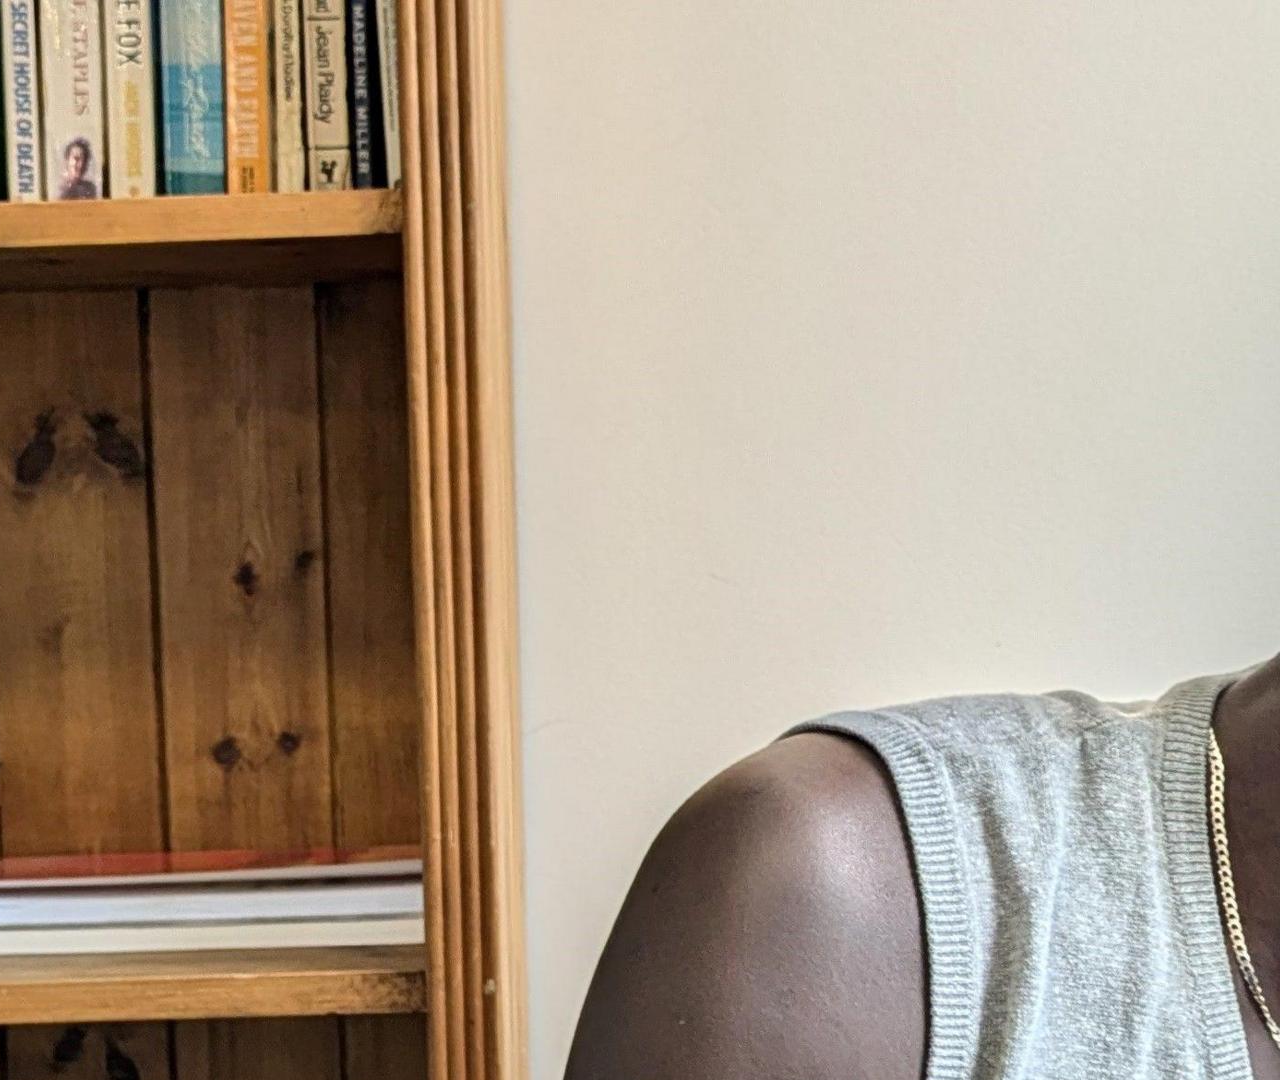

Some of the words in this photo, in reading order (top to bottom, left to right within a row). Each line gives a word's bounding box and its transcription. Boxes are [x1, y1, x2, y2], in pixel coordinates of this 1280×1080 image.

[117, 18, 142, 68] FOX
[315, 26, 333, 68] Jean
[351, 4, 370, 100] MADELINE
[13, 62, 33, 115] HOUSE
[16, 119, 33, 139] OF
[354, 106, 372, 174] MILLER
[17, 143, 35, 194] DEATH
